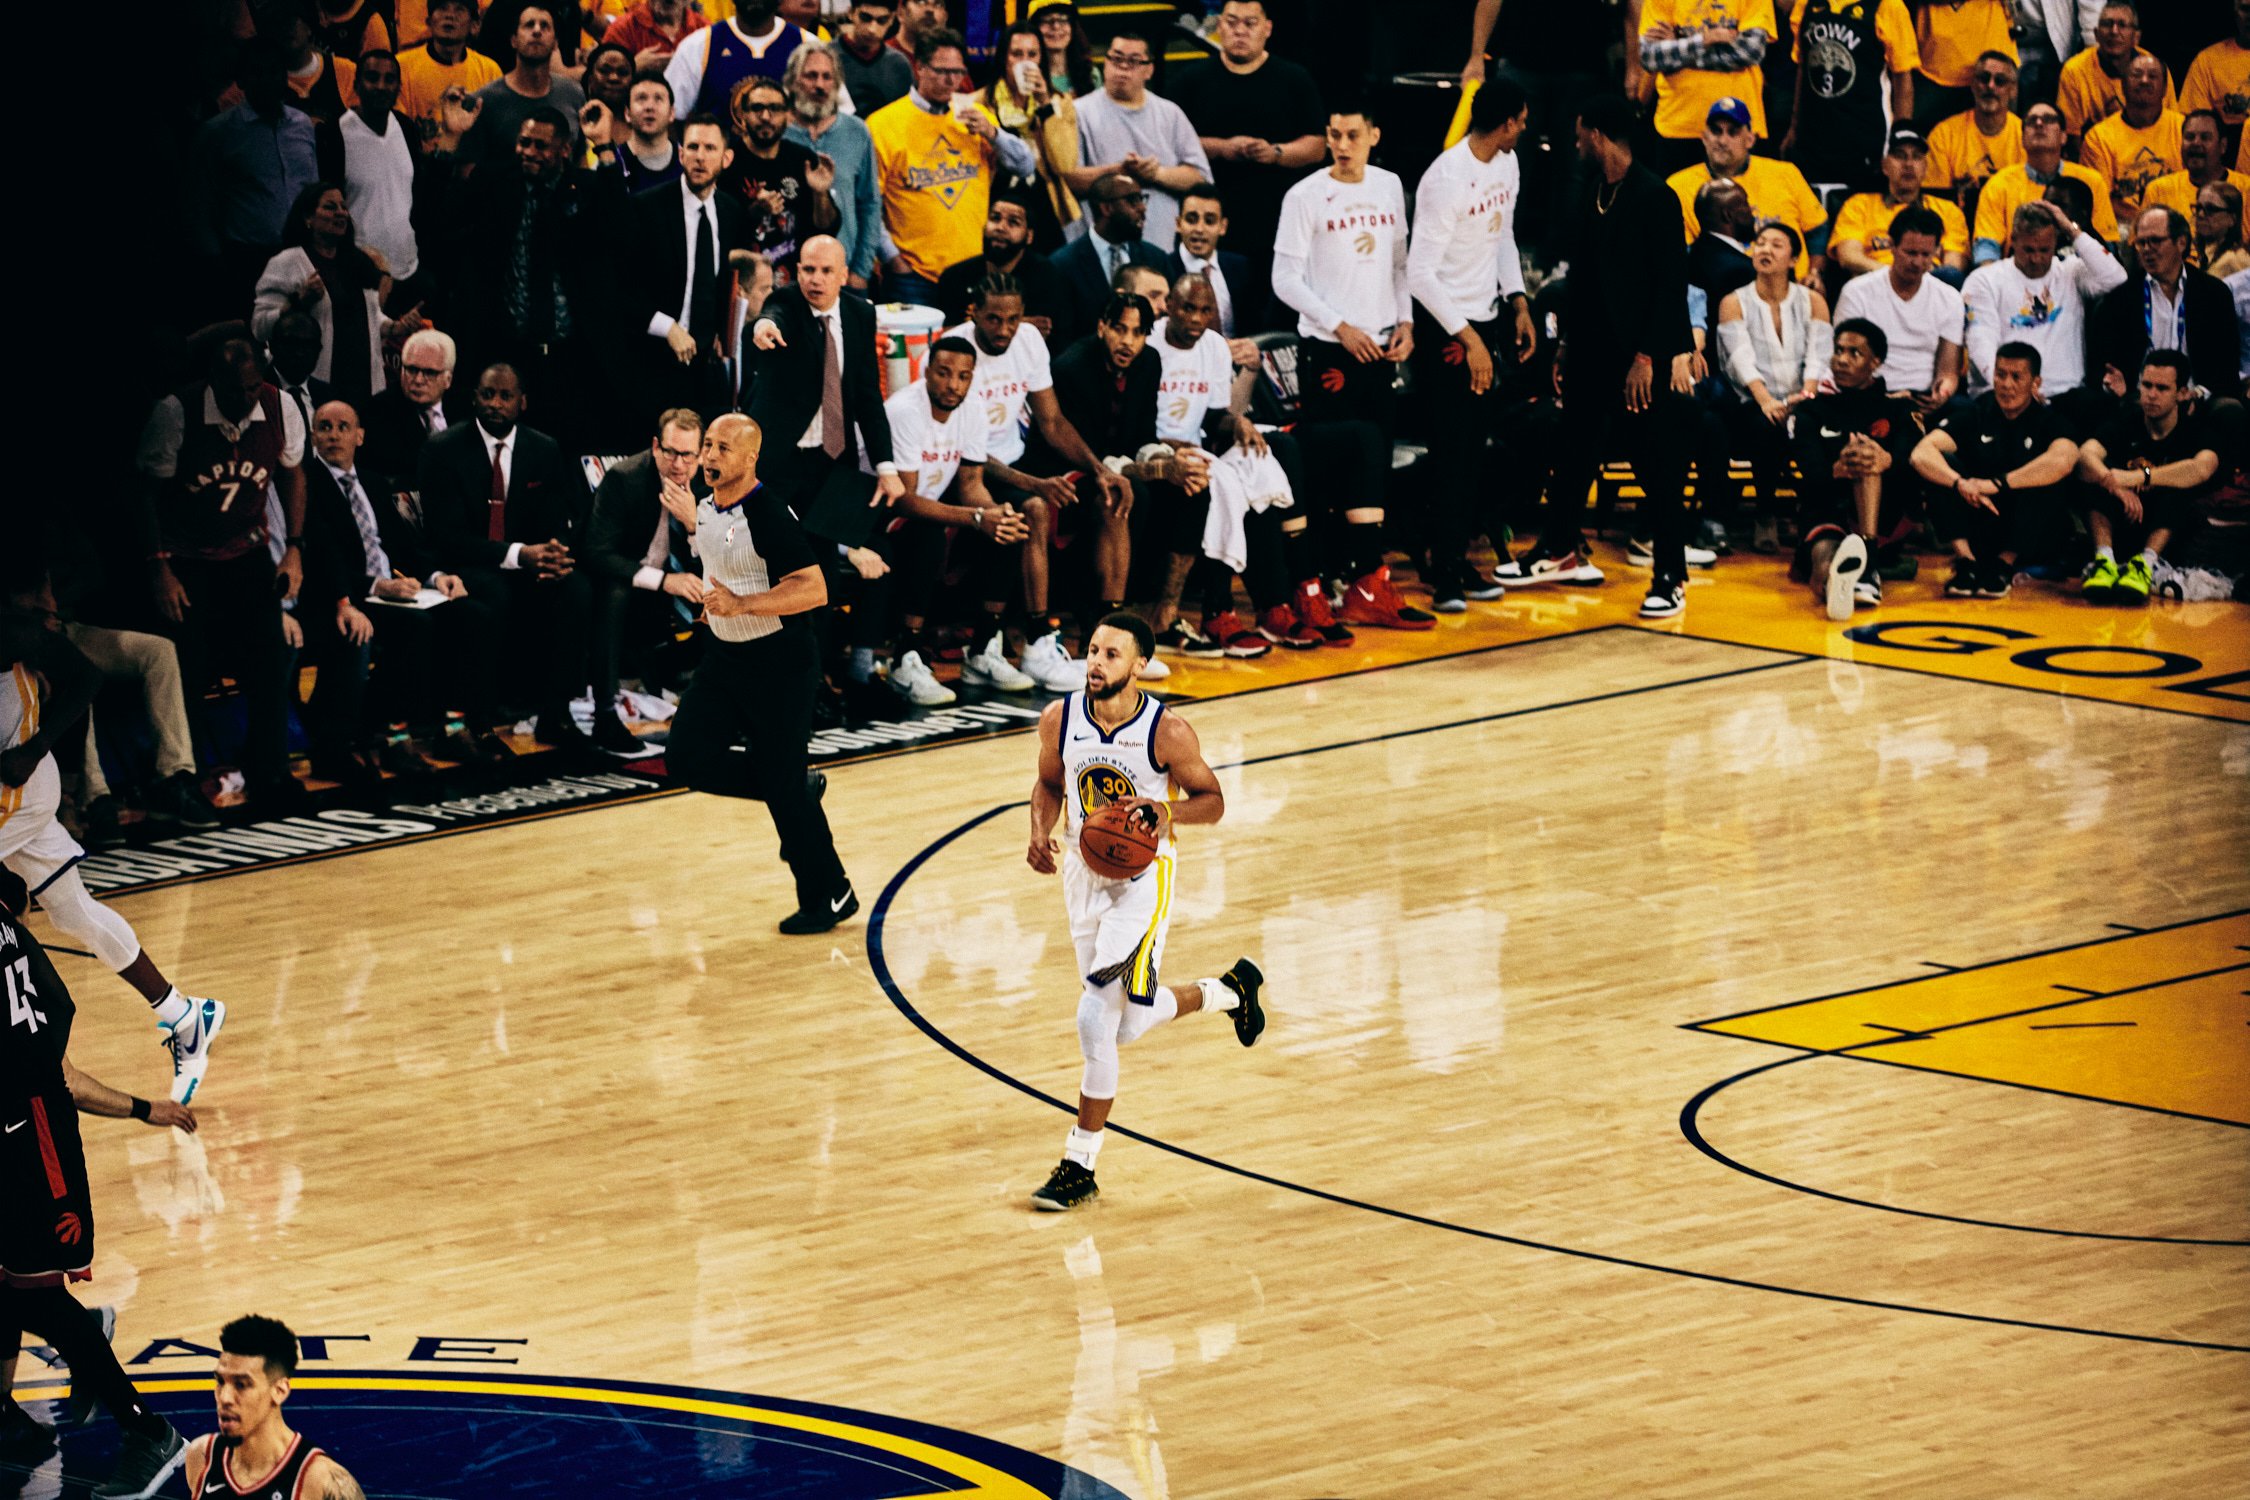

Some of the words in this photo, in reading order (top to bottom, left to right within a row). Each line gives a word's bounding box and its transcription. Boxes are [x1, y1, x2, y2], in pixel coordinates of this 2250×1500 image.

[1803, 21, 1861, 50] TOWN
[1822, 73, 1833, 97] 3
[1327, 213, 1395, 232] RAPTORS
[1159, 381, 1209, 394] APTORS
[219, 482, 241, 513] 7
[1118, 740, 1144, 748] Rakuten
[1073, 756, 1108, 774] GOLDEN
[1111, 758, 1138, 781] STATE
[1103, 776, 1127, 796] 30
[149, 809, 437, 864] FINALS
[4, 954, 48, 1034] 43
